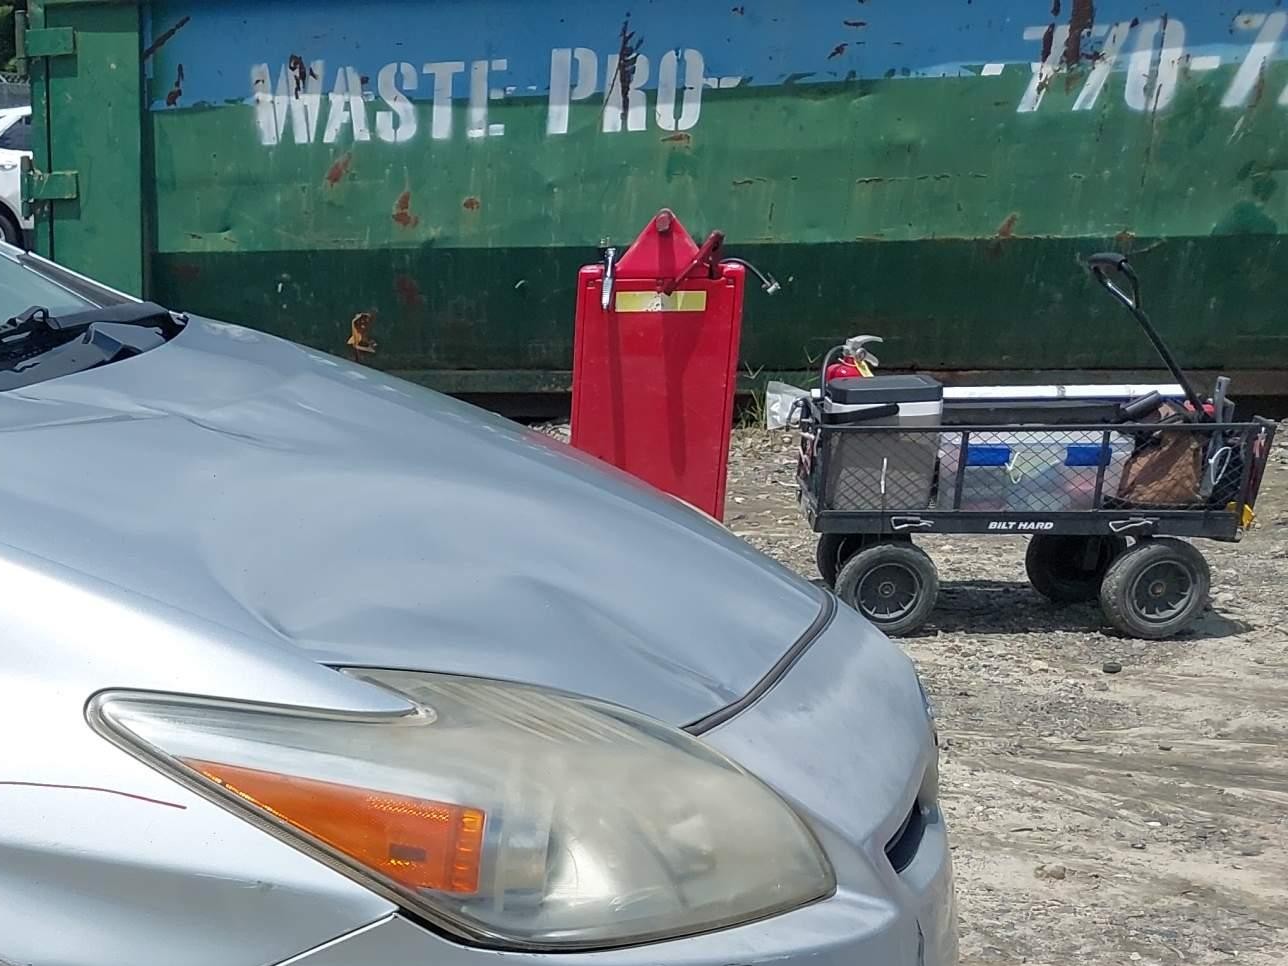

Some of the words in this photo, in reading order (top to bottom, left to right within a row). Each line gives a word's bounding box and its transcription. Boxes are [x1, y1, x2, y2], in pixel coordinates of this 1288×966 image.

[251, 59, 508, 145] WASTE
[546, 47, 706, 135] PRO
[1016, 12, 1288, 112] 770-7
[987, 521, 1015, 530] BILT
[1017, 521, 1054, 530] HARD
